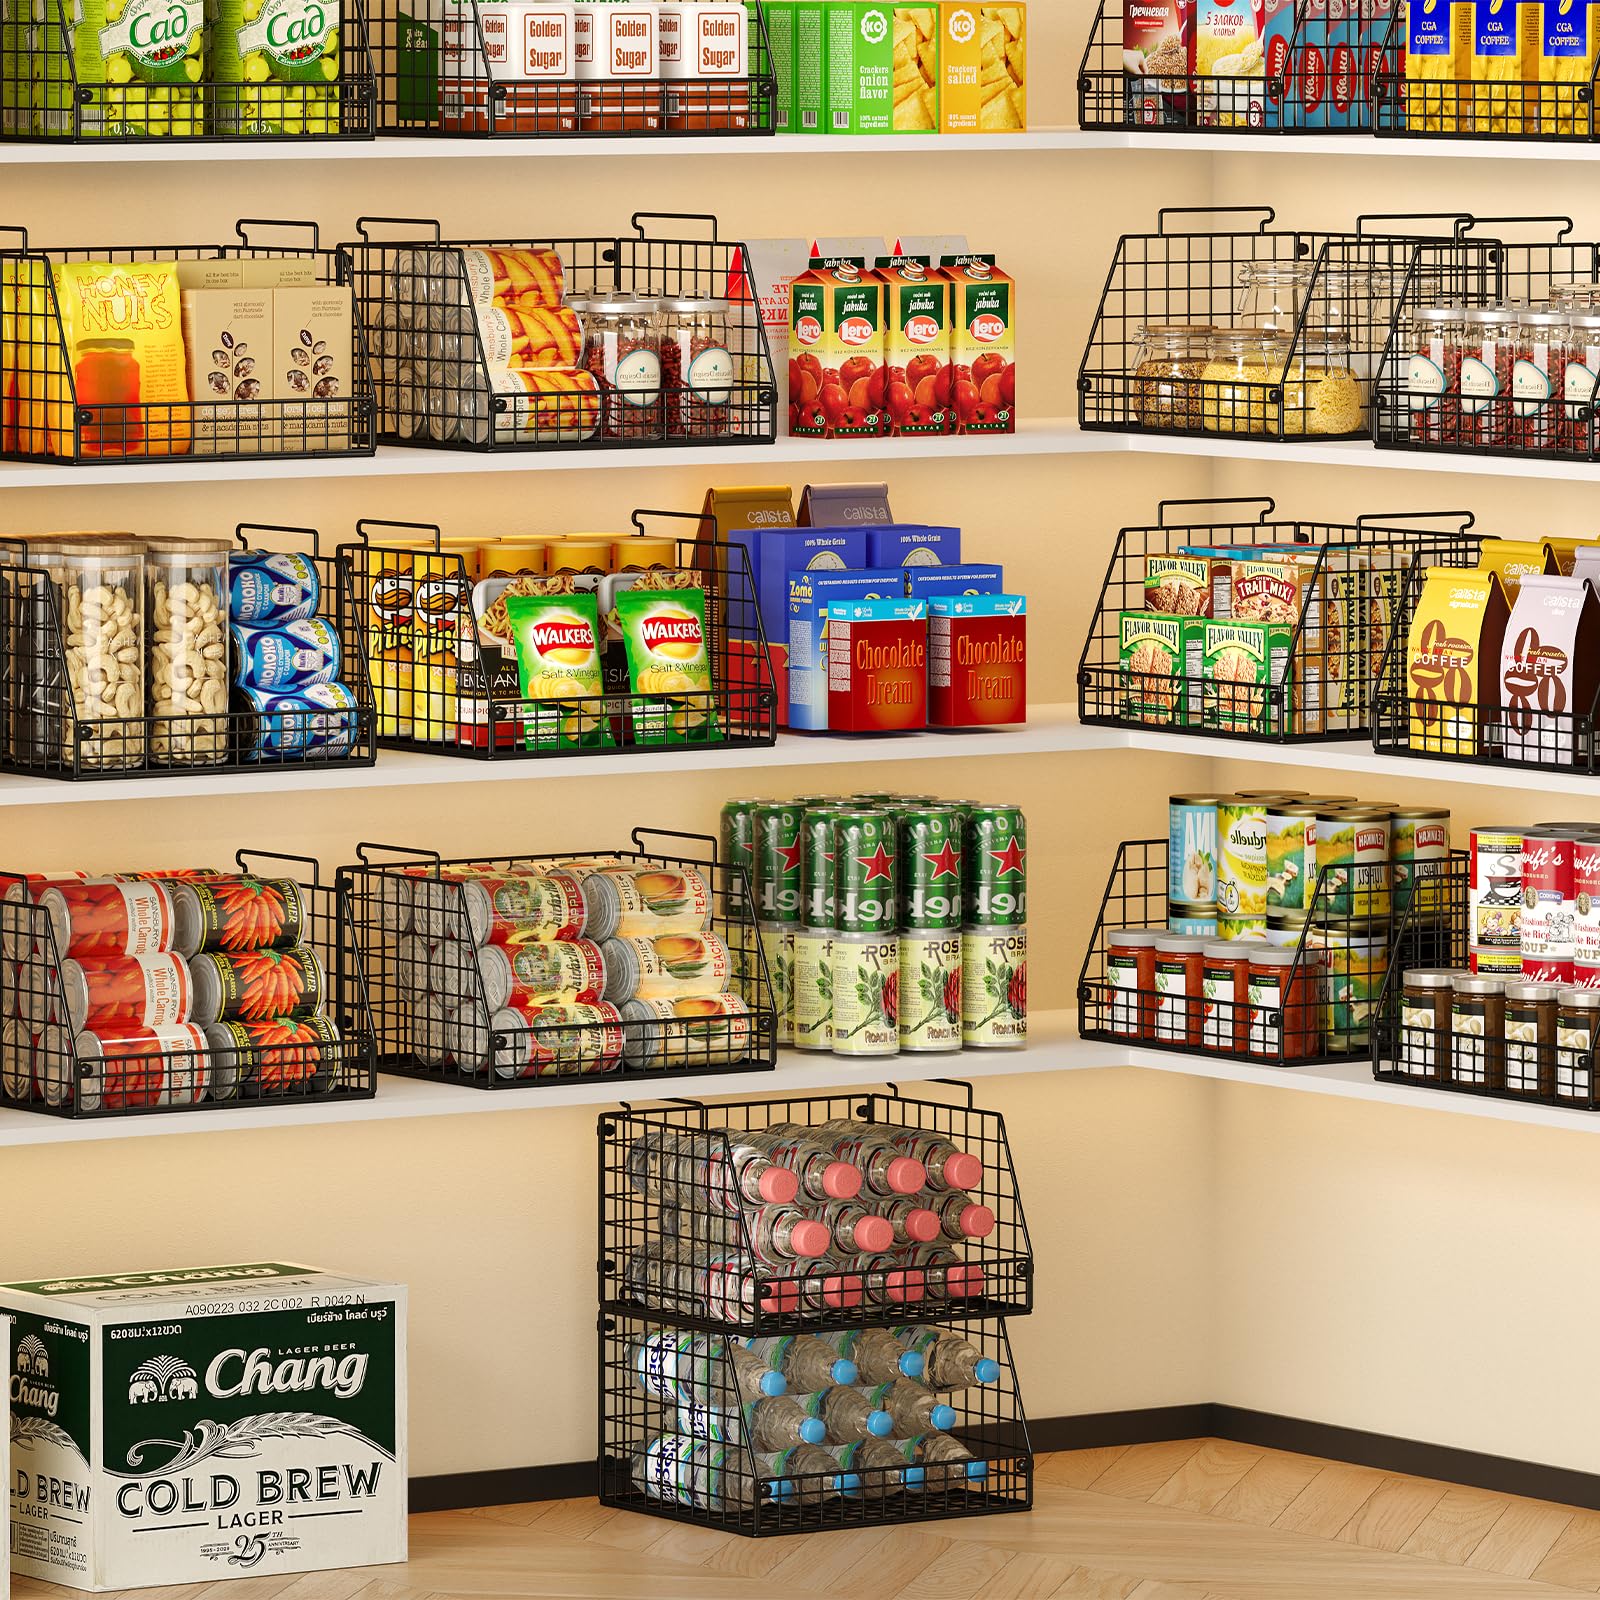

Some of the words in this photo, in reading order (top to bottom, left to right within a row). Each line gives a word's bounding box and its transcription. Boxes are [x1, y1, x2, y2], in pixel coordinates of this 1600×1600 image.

[1129, 4, 1170, 18] Гречневая
[1205, 11, 1212, 26] 5
[1213, 14, 1245, 27] злаков
[129, 4, 188, 48] Сад
[266, 4, 326, 48] Сад
[485, 20, 505, 33] Golden
[529, 20, 562, 38] Golden
[615, 20, 647, 38] Golden
[703, 19, 735, 37] Golden
[1421, 21, 1437, 32] CGA
[1487, 21, 1503, 32] CGA
[1556, 22, 1573, 33] CGA
[1415, 35, 1444, 45] COFFEE
[1480, 35, 1510, 46] COFFEE
[1548, 36, 1580, 47] COFFEE
[529, 48, 562, 69] Sugar
[615, 48, 648, 68] Sugar
[703, 47, 735, 68] Sugar
[859, 74, 889, 87] onion
[859, 86, 889, 99] flavor
[76, 273, 168, 301] HONEY
[479, 276, 491, 305] Whole
[81, 295, 173, 332] NUTS
[798, 299, 818, 313] jabuka
[842, 300, 868, 315] jabuka
[909, 299, 934, 313] jabuka
[974, 298, 1000, 312] jabuka
[797, 319, 820, 338] Lero
[841, 320, 872, 339] Lero
[907, 318, 938, 338] Lero
[972, 317, 1002, 337] Lero
[221, 331, 234, 348] new
[299, 329, 313, 347] new
[496, 333, 508, 363] Whole
[747, 510, 792, 525] calista
[843, 507, 888, 521] calista
[804, 538, 816, 547] 100%
[816, 538, 831, 547] Whole
[831, 538, 846, 546] Grain
[900, 535, 911, 544] 100%
[912, 535, 927, 543] Whole
[927, 534, 941, 543] Grain
[1149, 559, 1177, 577] FLAVOR
[1180, 561, 1207, 586] VALLEY
[1503, 563, 1541, 577] calista
[239, 571, 255, 620] МОЛОКО
[789, 581, 813, 597] Zomo
[1449, 587, 1486, 601] calista
[1543, 595, 1580, 610] calista
[532, 626, 594, 646] WALKERS
[642, 621, 702, 641] WALKERS
[1124, 621, 1151, 643] FLAVOR
[1153, 621, 1178, 647] VALLEY
[957, 634, 1023, 665] Chocolate
[1208, 627, 1235, 650] FLAVOR
[1237, 630, 1263, 656] VALLEY
[1432, 640, 1447, 650] fresh
[1447, 641, 1474, 650] roasted
[856, 638, 924, 670] Chocolate
[1414, 653, 1469, 669] COFFEE
[1527, 647, 1543, 657] fresh
[260, 637, 277, 687] МОЛОКО
[650, 664, 672, 675] Salt
[1508, 662, 1563, 676] COFFEE
[541, 670, 563, 680] Salt
[867, 674, 912, 705] Dream
[968, 670, 1013, 701] Dream
[1521, 847, 1564, 870] wift's
[619, 881, 632, 904] PIE
[682, 868, 706, 916] PEACHES
[135, 896, 150, 926] Whole
[561, 879, 580, 925] APPLES
[149, 896, 160, 948] SAINSBURY'S
[136, 926, 152, 954] Carrots
[1532, 929, 1551, 940] Rice
[640, 943, 651, 965] PIE
[700, 931, 725, 978] PEACHES
[1521, 942, 1549, 953] SOUP
[583, 943, 600, 989] APPLES
[153, 967, 168, 997] Whole
[154, 998, 170, 1026] Carrots
[184, 1301, 236, 1316] A090223
[238, 1300, 261, 1314] 032
[311, 1297, 320, 1308] R
[356, 1293, 366, 1305] N
[278, 1345, 319, 1355] LAGER
[323, 1342, 357, 1352] BEER
[204, 1347, 369, 1399] Chang
[10, 1374, 60, 1418] Chang
[37, 1473, 90, 1514] BREW
[116, 1474, 241, 1518] COLD
[256, 1461, 383, 1506] BREW
[19, 1502, 49, 1521] LAGER
[217, 1510, 284, 1530] LAGER
[227, 1531, 272, 1569] 25
[271, 1531, 283, 1539] TH
[267, 1540, 300, 1548] ANNIVERSARY
